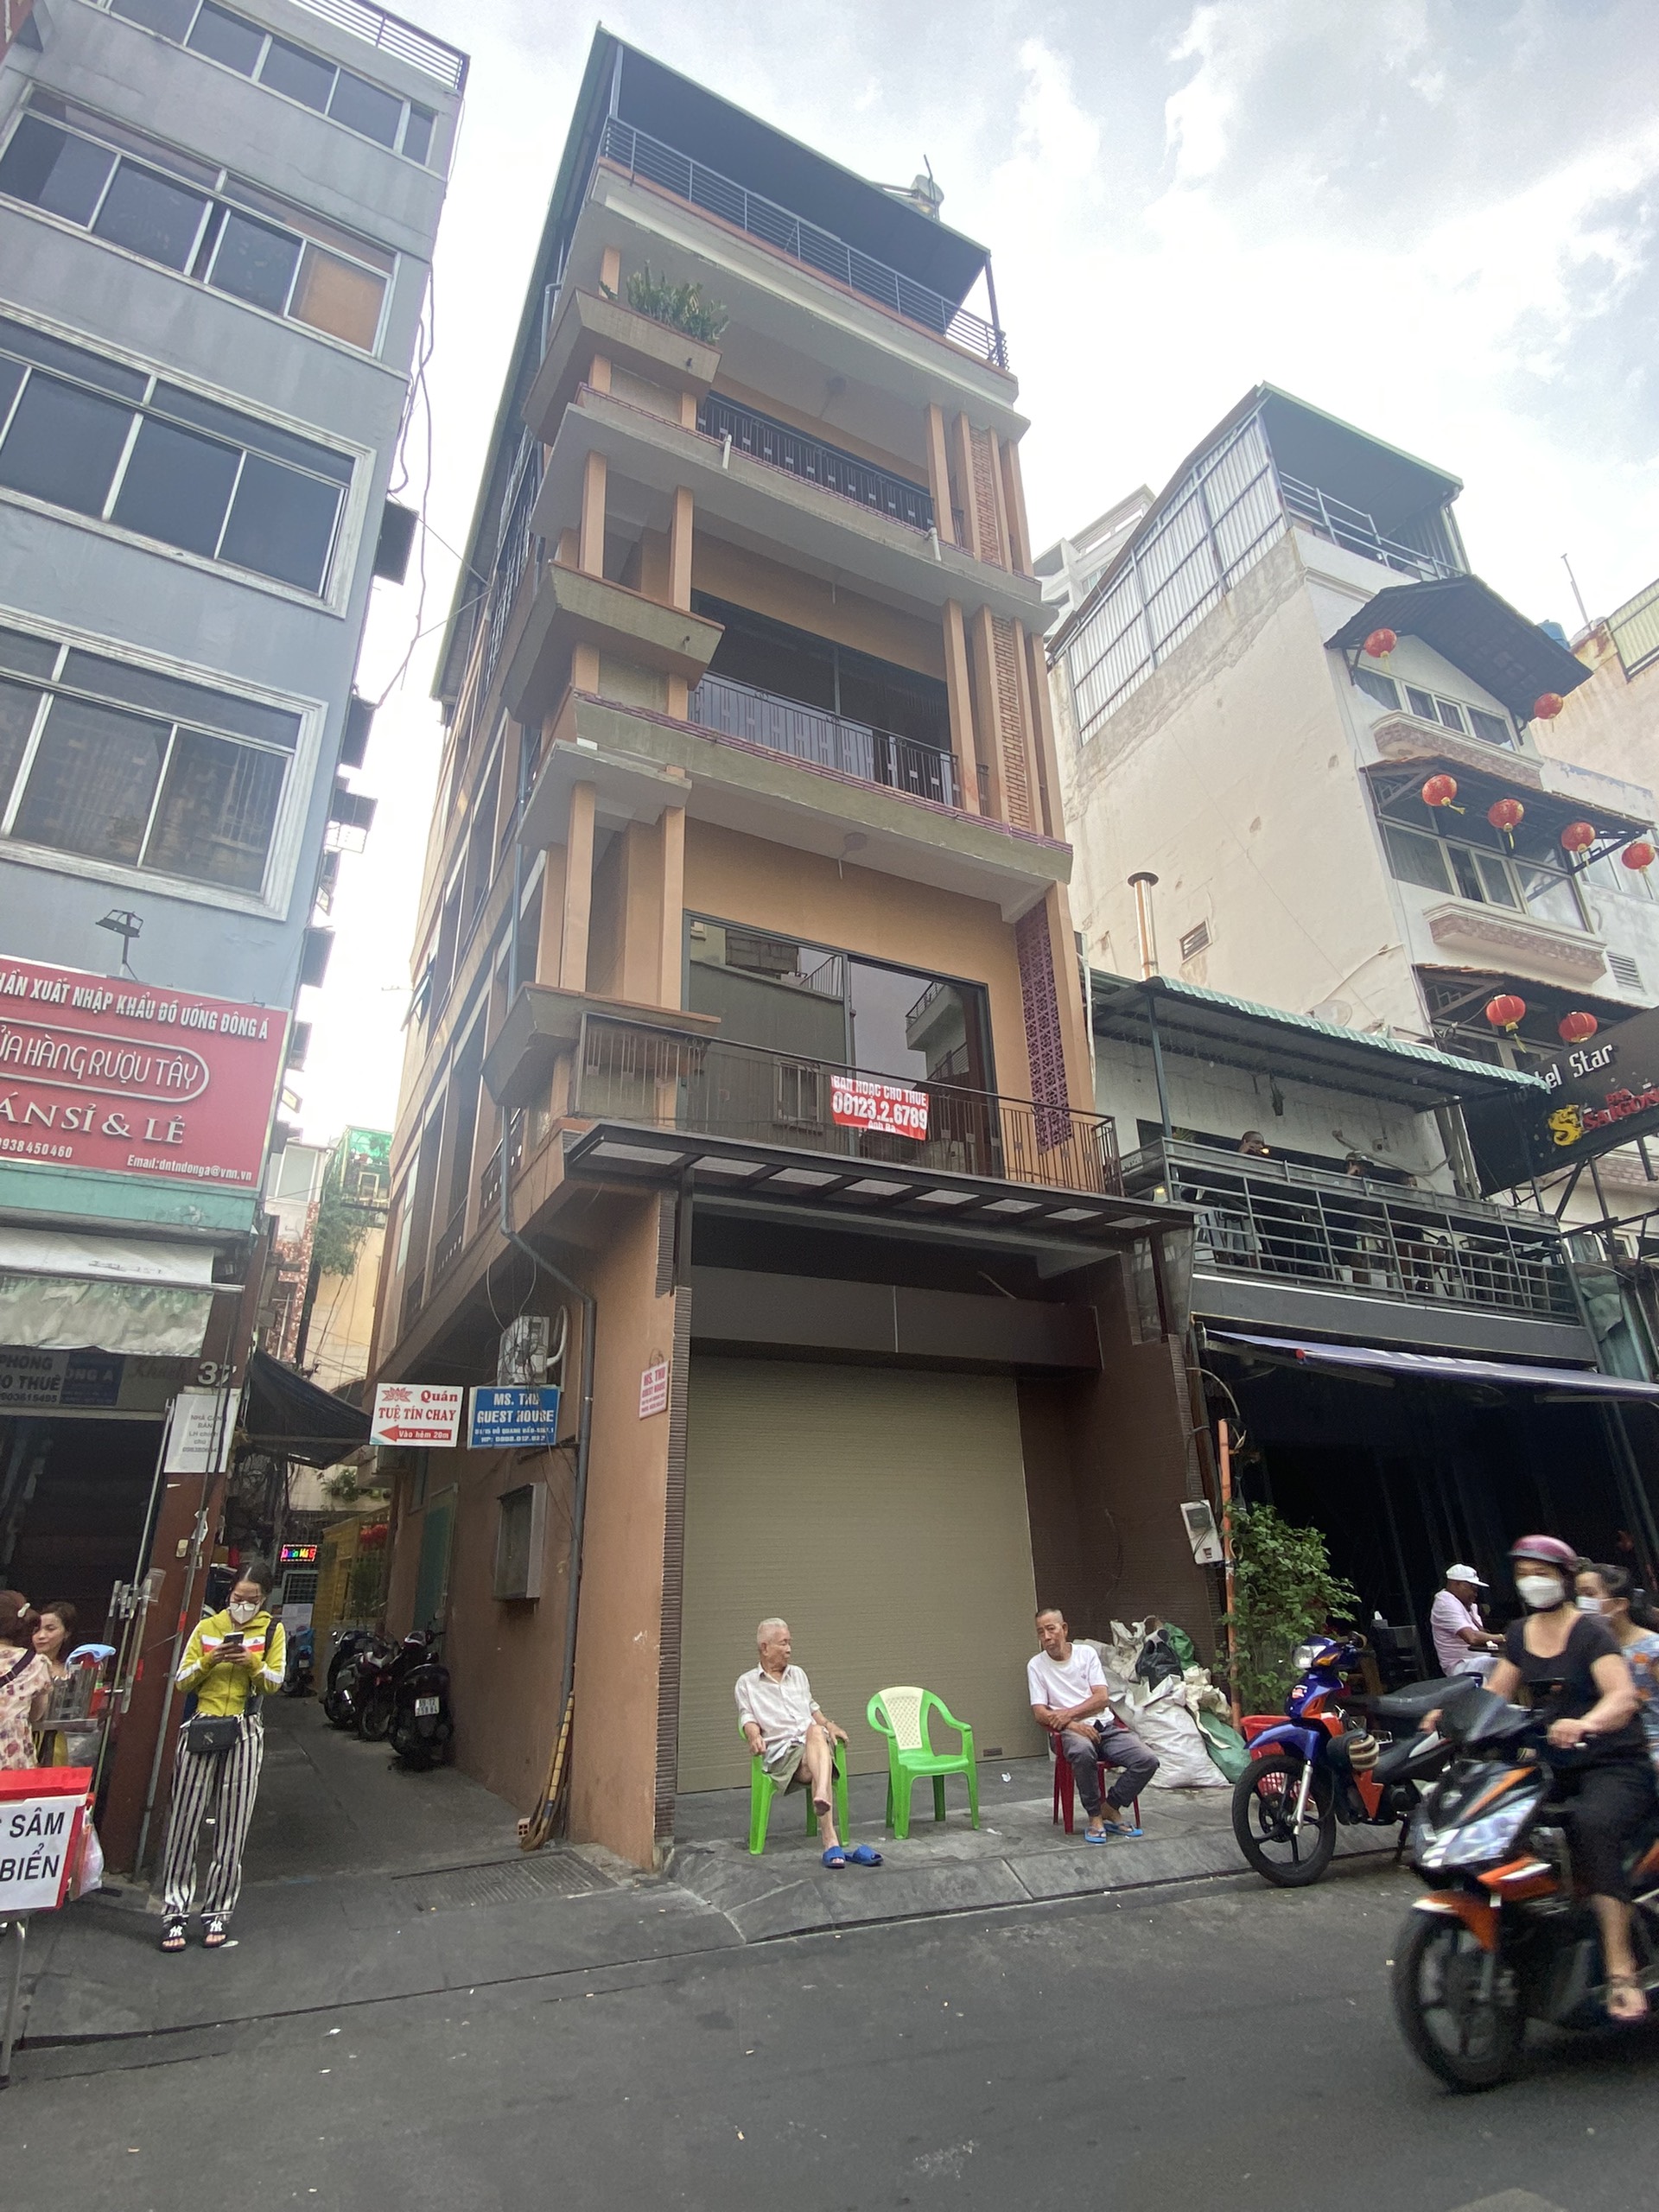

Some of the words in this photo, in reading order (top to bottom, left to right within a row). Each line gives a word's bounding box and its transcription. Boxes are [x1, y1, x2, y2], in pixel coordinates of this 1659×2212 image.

[29, 977, 71, 1003] XUẤT
[72, 986, 114, 1014] NHẬP
[115, 992, 156, 1020] KHẨU
[180, 1003, 218, 1031] UỐNG
[220, 1011, 258, 1038] ĐÔNG
[258, 1017, 270, 1039] Á
[23, 1033, 87, 1079] HÀNG
[88, 1049, 151, 1084] RƯỢU
[156, 1054, 199, 1090] TÂY
[1568, 1044, 1613, 1078] Star
[883, 1085, 902, 1102] CHO
[832, 1090, 928, 1130] 08123.2.6789
[101, 1112, 132, 1139] &
[143, 1114, 186, 1144] LẺ
[0, 1137, 24, 1153] 938
[19, 1375, 60, 1391] THUÊ
[421, 1389, 458, 1403] Quán
[493, 1393, 515, 1406] MS.
[378, 1404, 401, 1422] TUỆ
[404, 1405, 423, 1420] TÍN
[426, 1409, 456, 1421] CHAY
[477, 1410, 513, 1424] GUEST
[516, 1410, 554, 1423] HOUSE
[10, 1807, 65, 1838] SÂM
[0, 1842, 60, 1882] BIỂN
